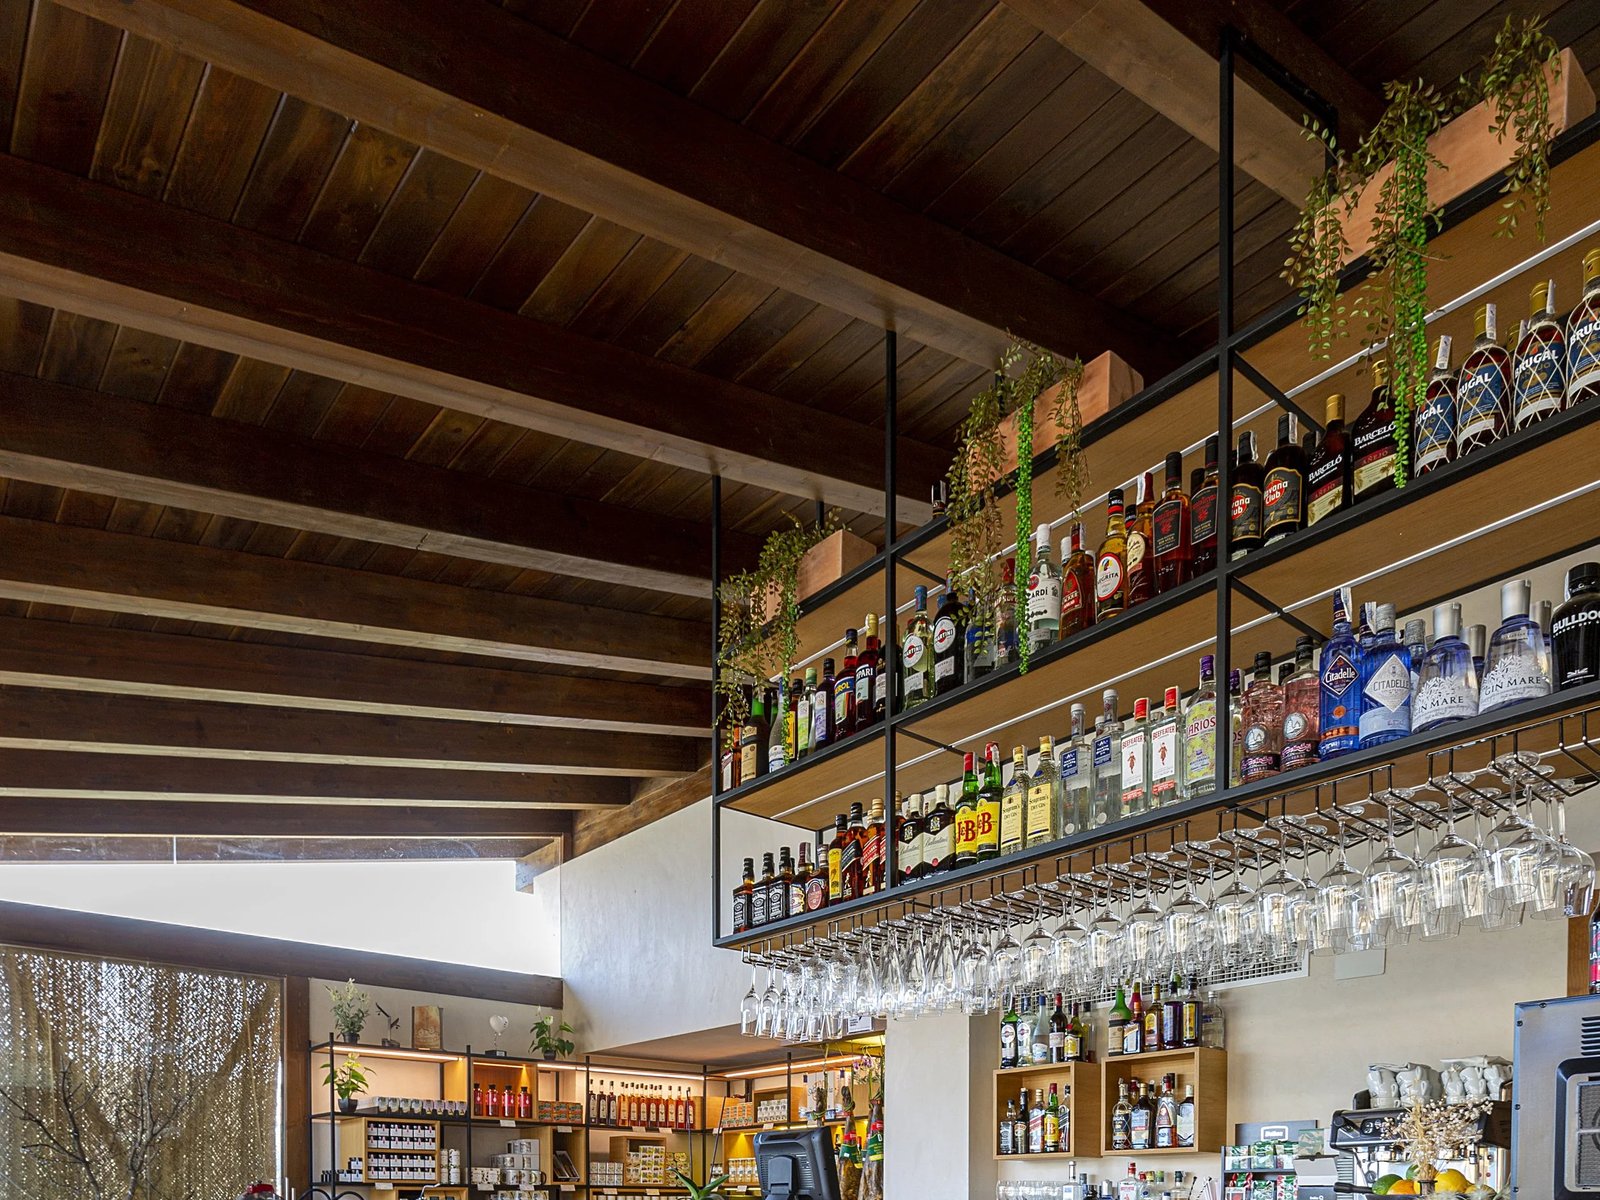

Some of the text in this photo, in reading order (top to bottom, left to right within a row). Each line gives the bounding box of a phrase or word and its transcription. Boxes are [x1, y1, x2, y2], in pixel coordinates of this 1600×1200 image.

[1569, 319, 1600, 348] BRUG
[1514, 349, 1559, 379] BRUGAL
[1353, 420, 1397, 447] BARCELÓ
[1307, 453, 1343, 482] BARCELÓ
[1552, 610, 1600, 634] BULLDO
[1325, 667, 1356, 683] Citadelle
[1373, 679, 1410, 692] CITADELLE
[1484, 676, 1542, 696] GIN MARE
[1430, 695, 1464, 709] MARE
